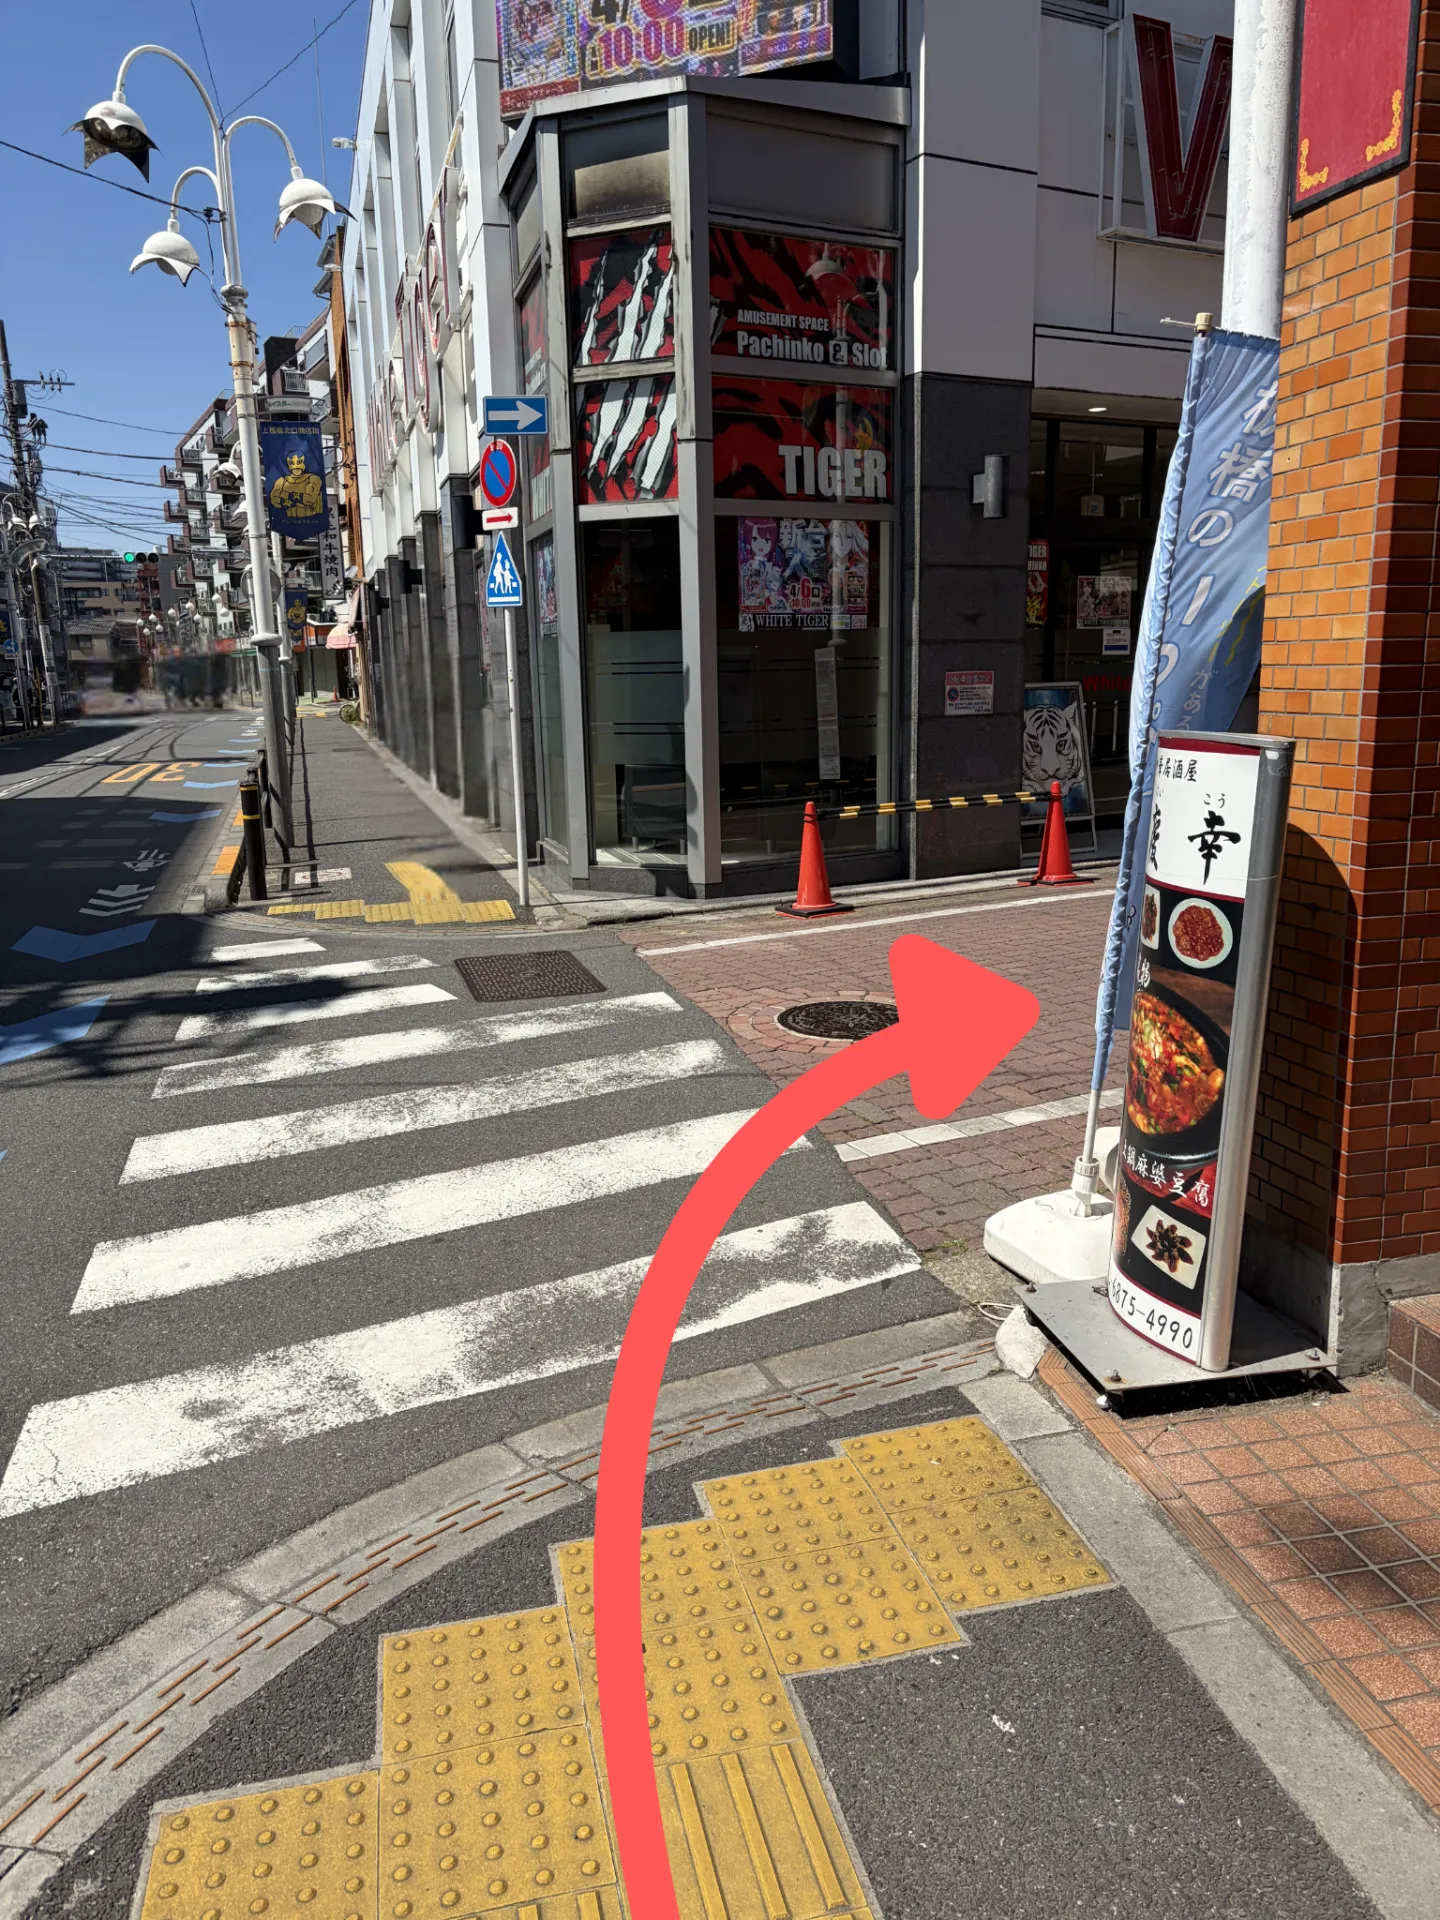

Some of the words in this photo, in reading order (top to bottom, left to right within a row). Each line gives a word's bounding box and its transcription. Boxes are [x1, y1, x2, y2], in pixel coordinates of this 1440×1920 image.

[598, 16, 685, 70] 10:00
[689, 22, 732, 52] OPEN!
[737, 308, 798, 328] AMUSEMENT
[799, 316, 830, 332] SPACE
[737, 330, 825, 363] Pachinko
[852, 341, 888, 369] Slot
[779, 445, 888, 498] TIGER
[778, 518, 829, 550] 新台
[756, 614, 792, 627] WHITE
[795, 614, 830, 627] TIGER
[1203, 792, 1228, 809] こう
